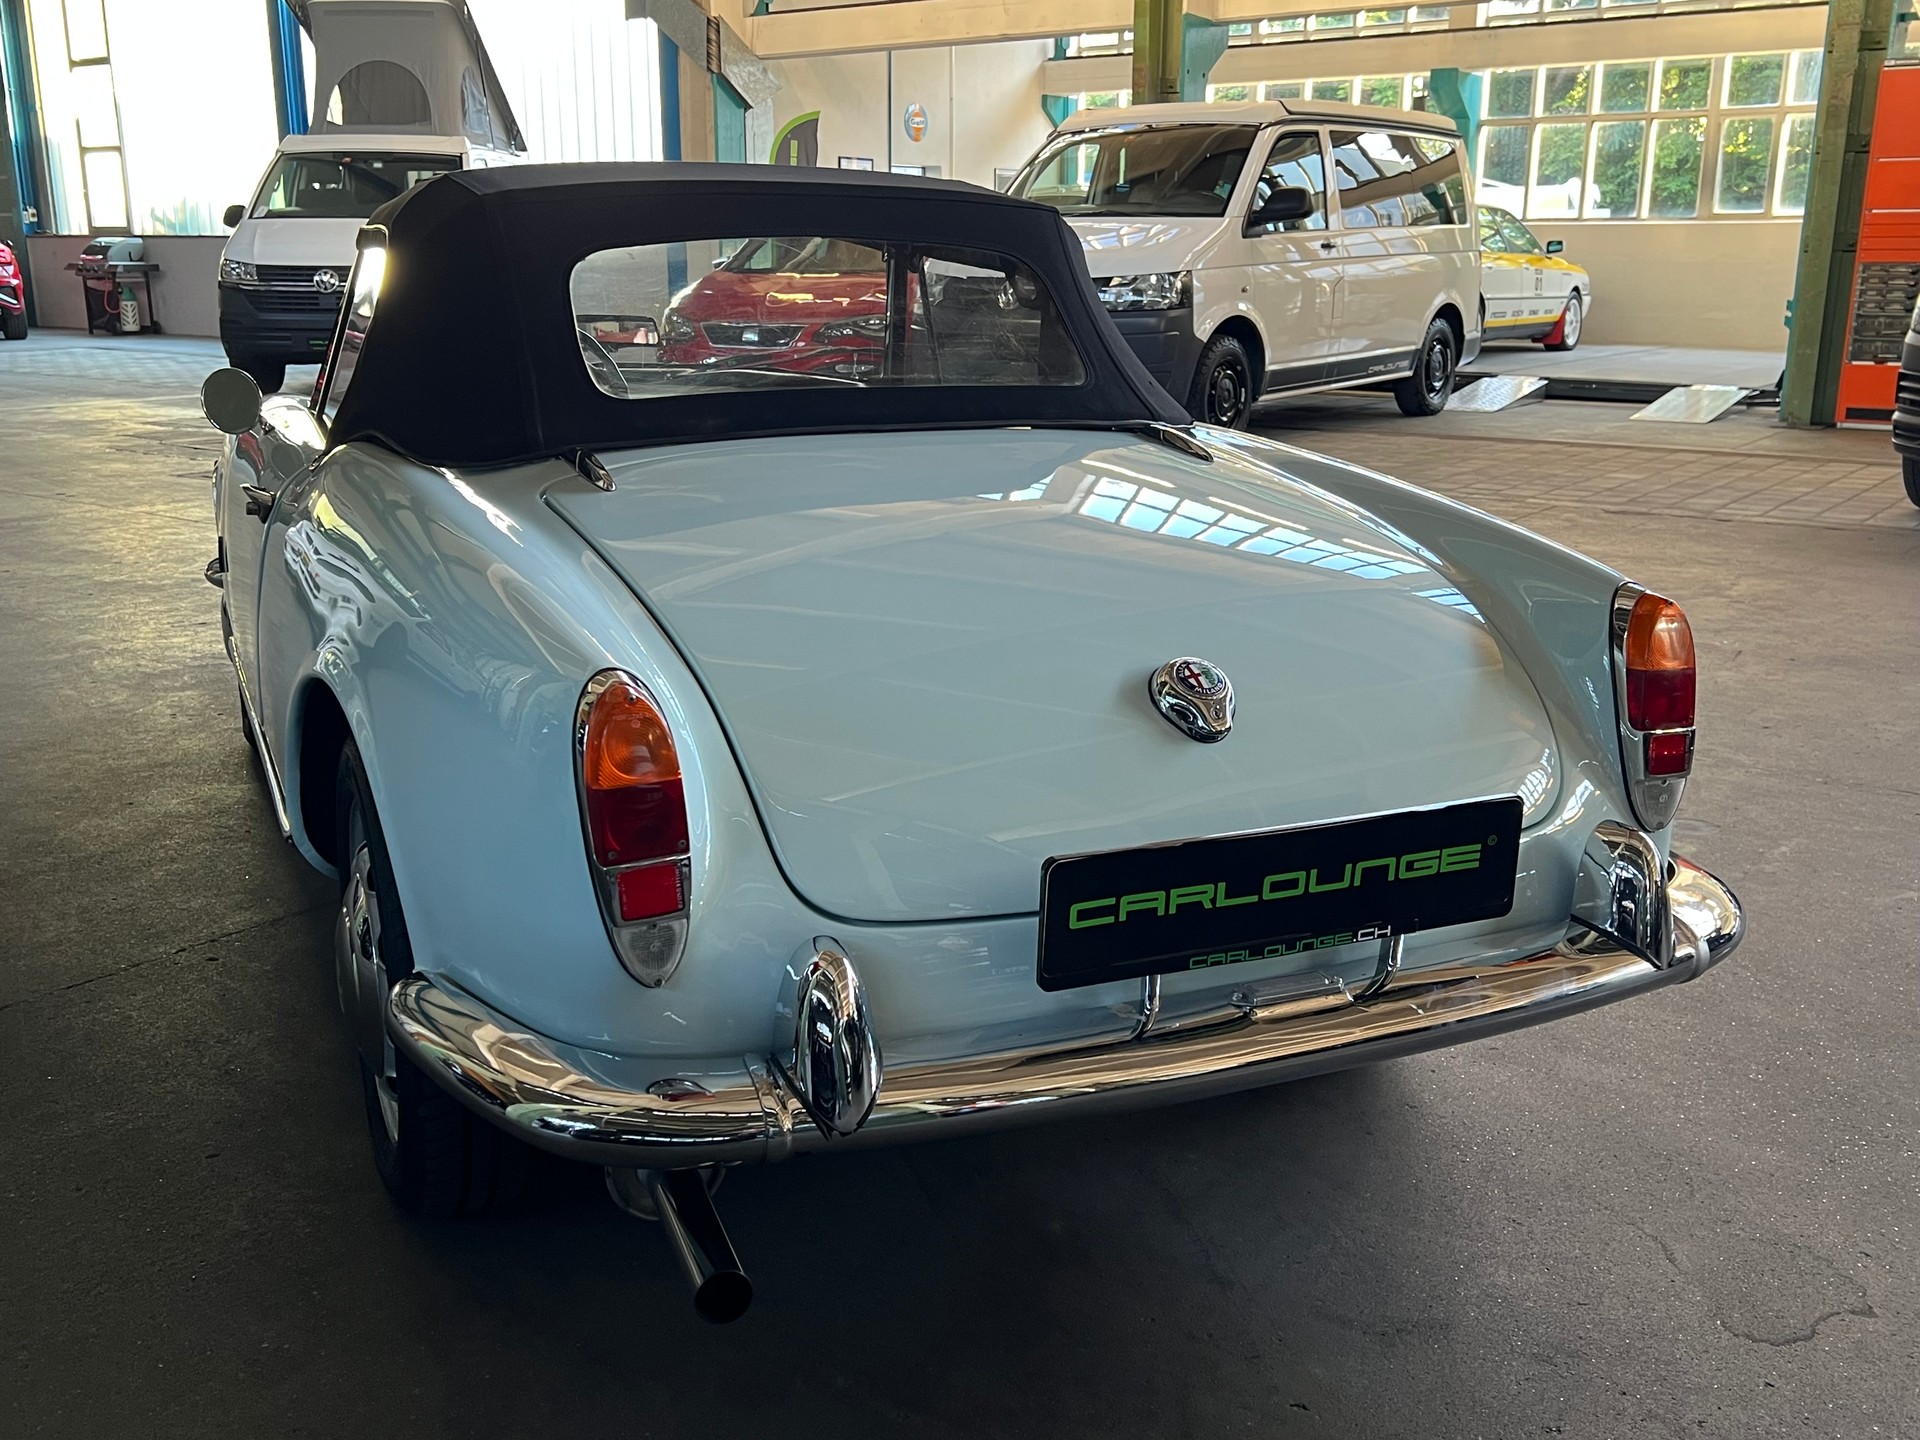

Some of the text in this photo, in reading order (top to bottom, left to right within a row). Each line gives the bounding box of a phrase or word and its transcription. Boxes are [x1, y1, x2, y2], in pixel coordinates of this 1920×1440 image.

[1535, 276, 1543, 292] 01
[1194, 682, 1223, 694] MILANO
[1068, 843, 1483, 930] CARLOUNGE
[1189, 925, 1391, 970] CARLOUNGE.CH
